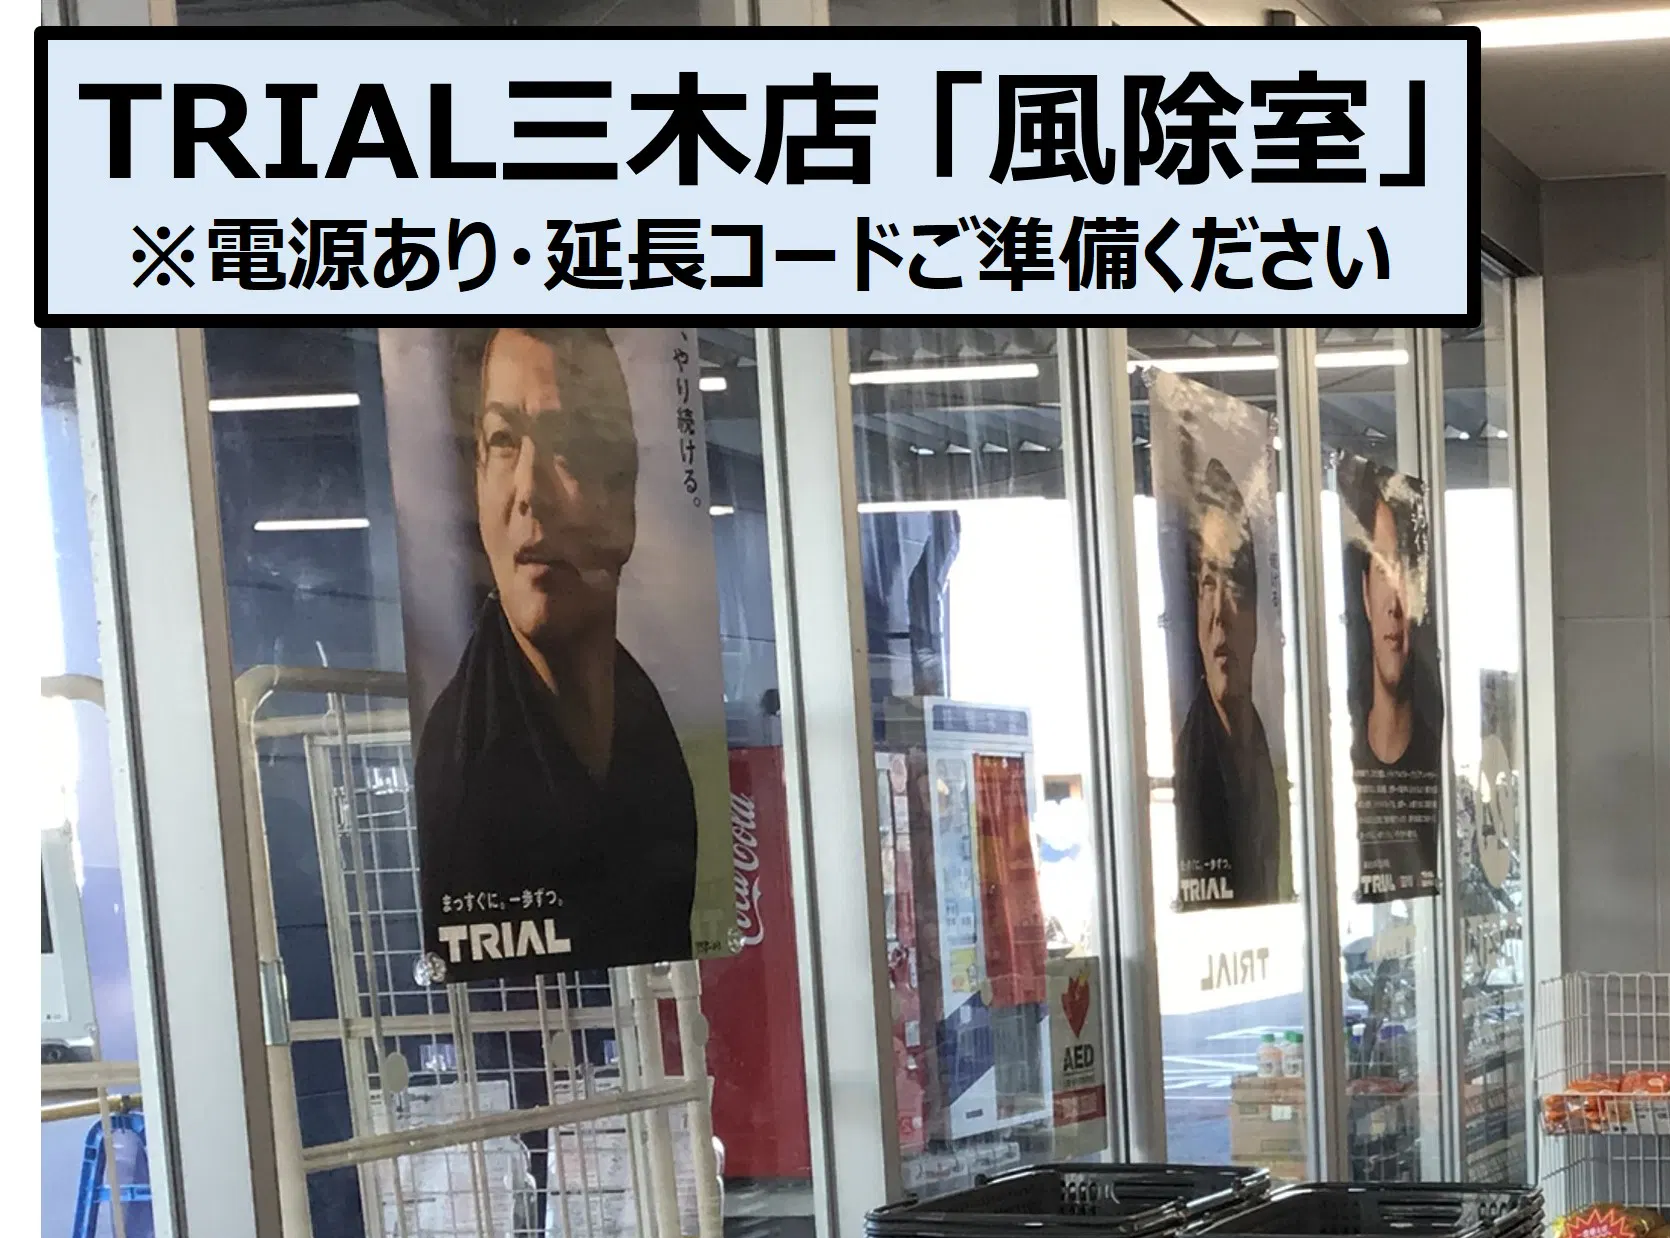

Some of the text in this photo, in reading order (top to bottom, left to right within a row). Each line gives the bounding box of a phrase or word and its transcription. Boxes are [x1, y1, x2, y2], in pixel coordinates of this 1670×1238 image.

[1180, 876, 1234, 902] TRIAL
[438, 918, 571, 963] TRIAL
[1063, 1044, 1095, 1071] AED
